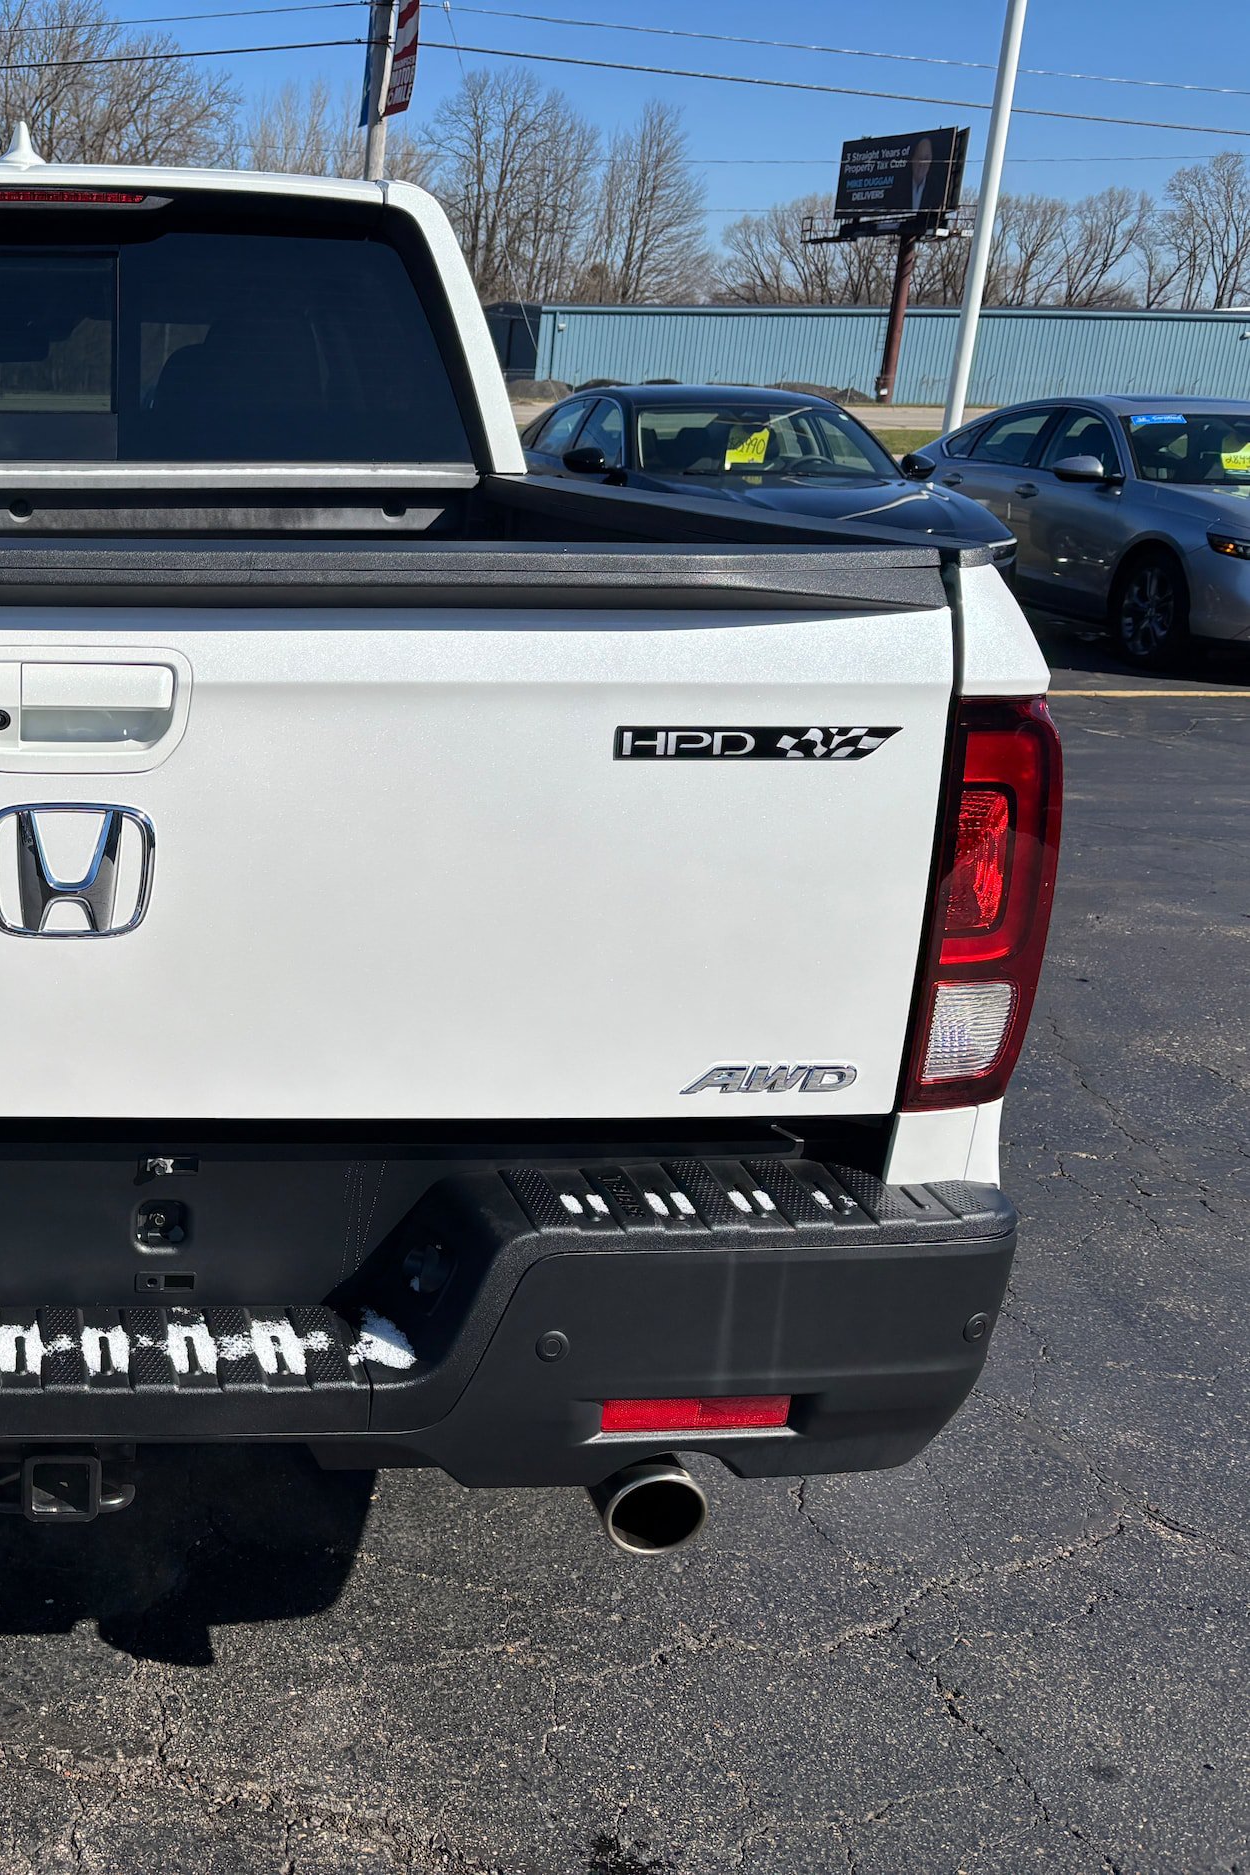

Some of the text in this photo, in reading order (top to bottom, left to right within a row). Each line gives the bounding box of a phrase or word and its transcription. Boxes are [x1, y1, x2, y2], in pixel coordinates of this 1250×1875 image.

[852, 150, 880, 161] Straight
[881, 149, 900, 158] Years
[901, 146, 910, 156] of
[844, 159, 907, 174] Property Tax Cuts
[847, 176, 894, 188] MIKE DUGGAN
[852, 190, 885, 201] DELIVERS
[621, 731, 756, 756] HPD
[678, 1063, 858, 1095] AWD
